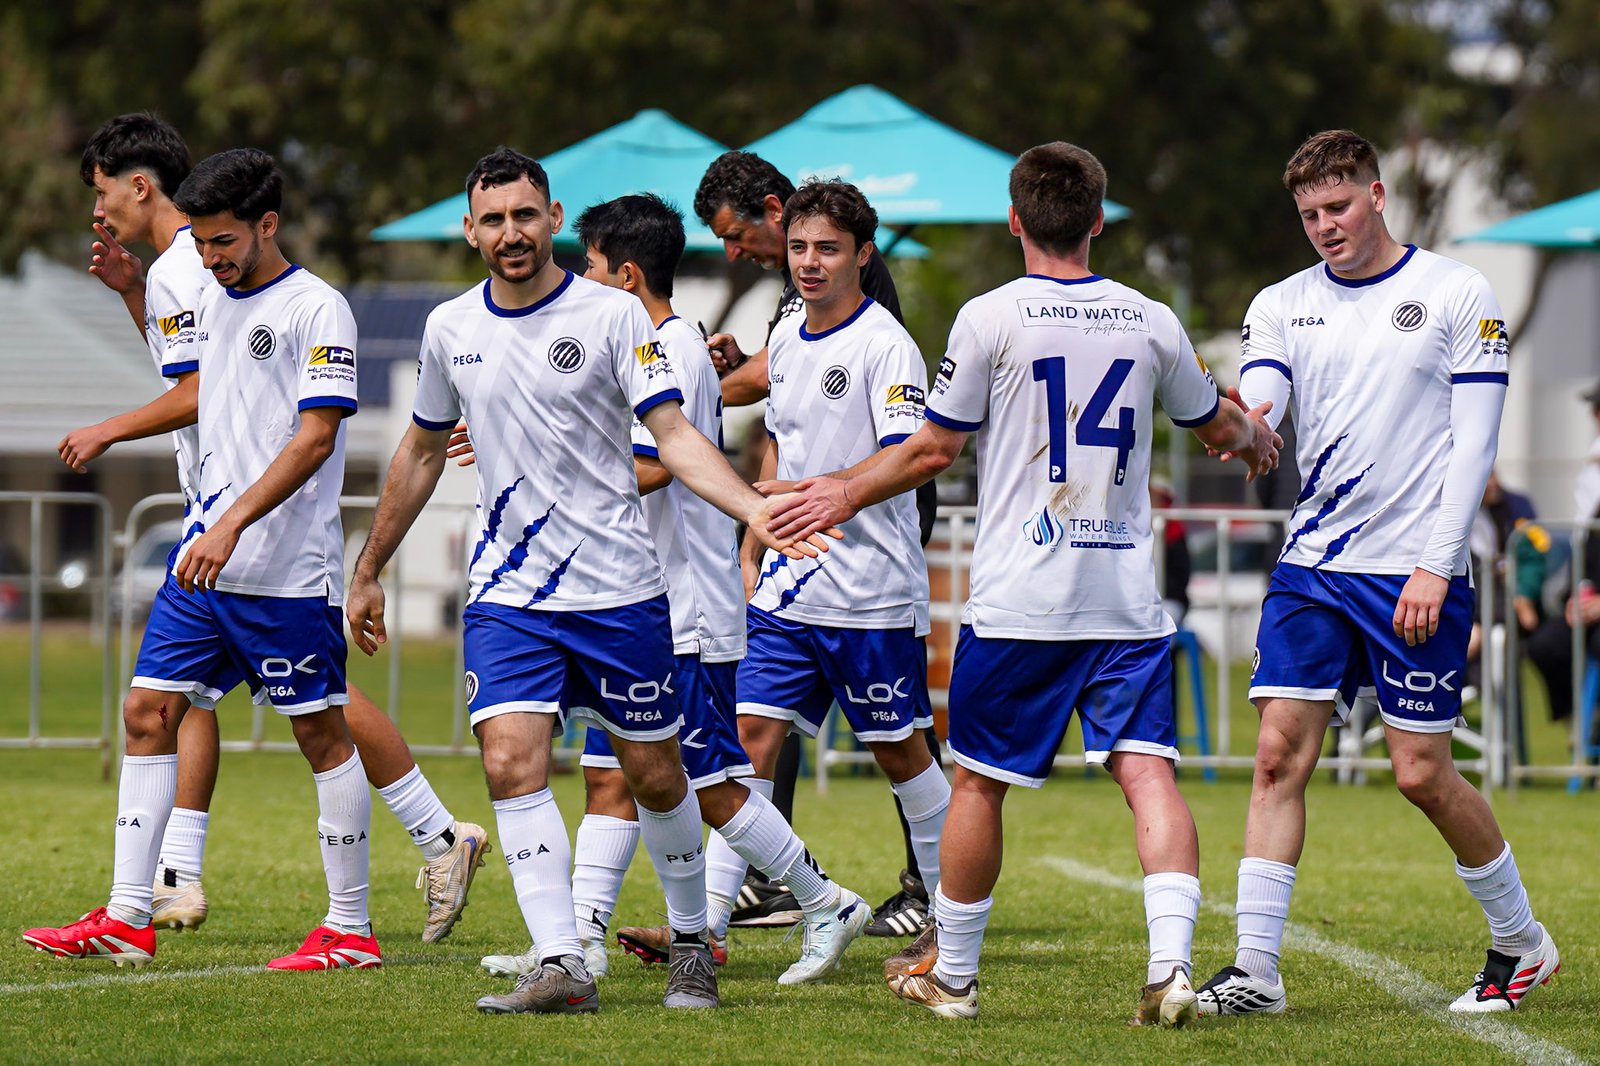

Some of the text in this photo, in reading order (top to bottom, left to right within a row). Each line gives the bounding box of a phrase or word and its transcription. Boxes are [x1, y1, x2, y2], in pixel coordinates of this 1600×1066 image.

[1026, 306, 1144, 323] LAND WATCH
[1291, 317, 1325, 327] PEGA
[1082, 319, 1138, 336] Australia
[330, 349, 353, 362] HP
[453, 353, 483, 367] PEGA
[1032, 356, 1136, 486] 14
[257, 653, 318, 678] OK
[1382, 660, 1457, 692] LOK
[601, 672, 674, 703] LOK
[845, 676, 909, 703] LOK
[1397, 698, 1435, 712] PEGA
[625, 709, 663, 721] PEGA
[871, 711, 899, 722] PEGA
[506, 843, 550, 866] EGA
